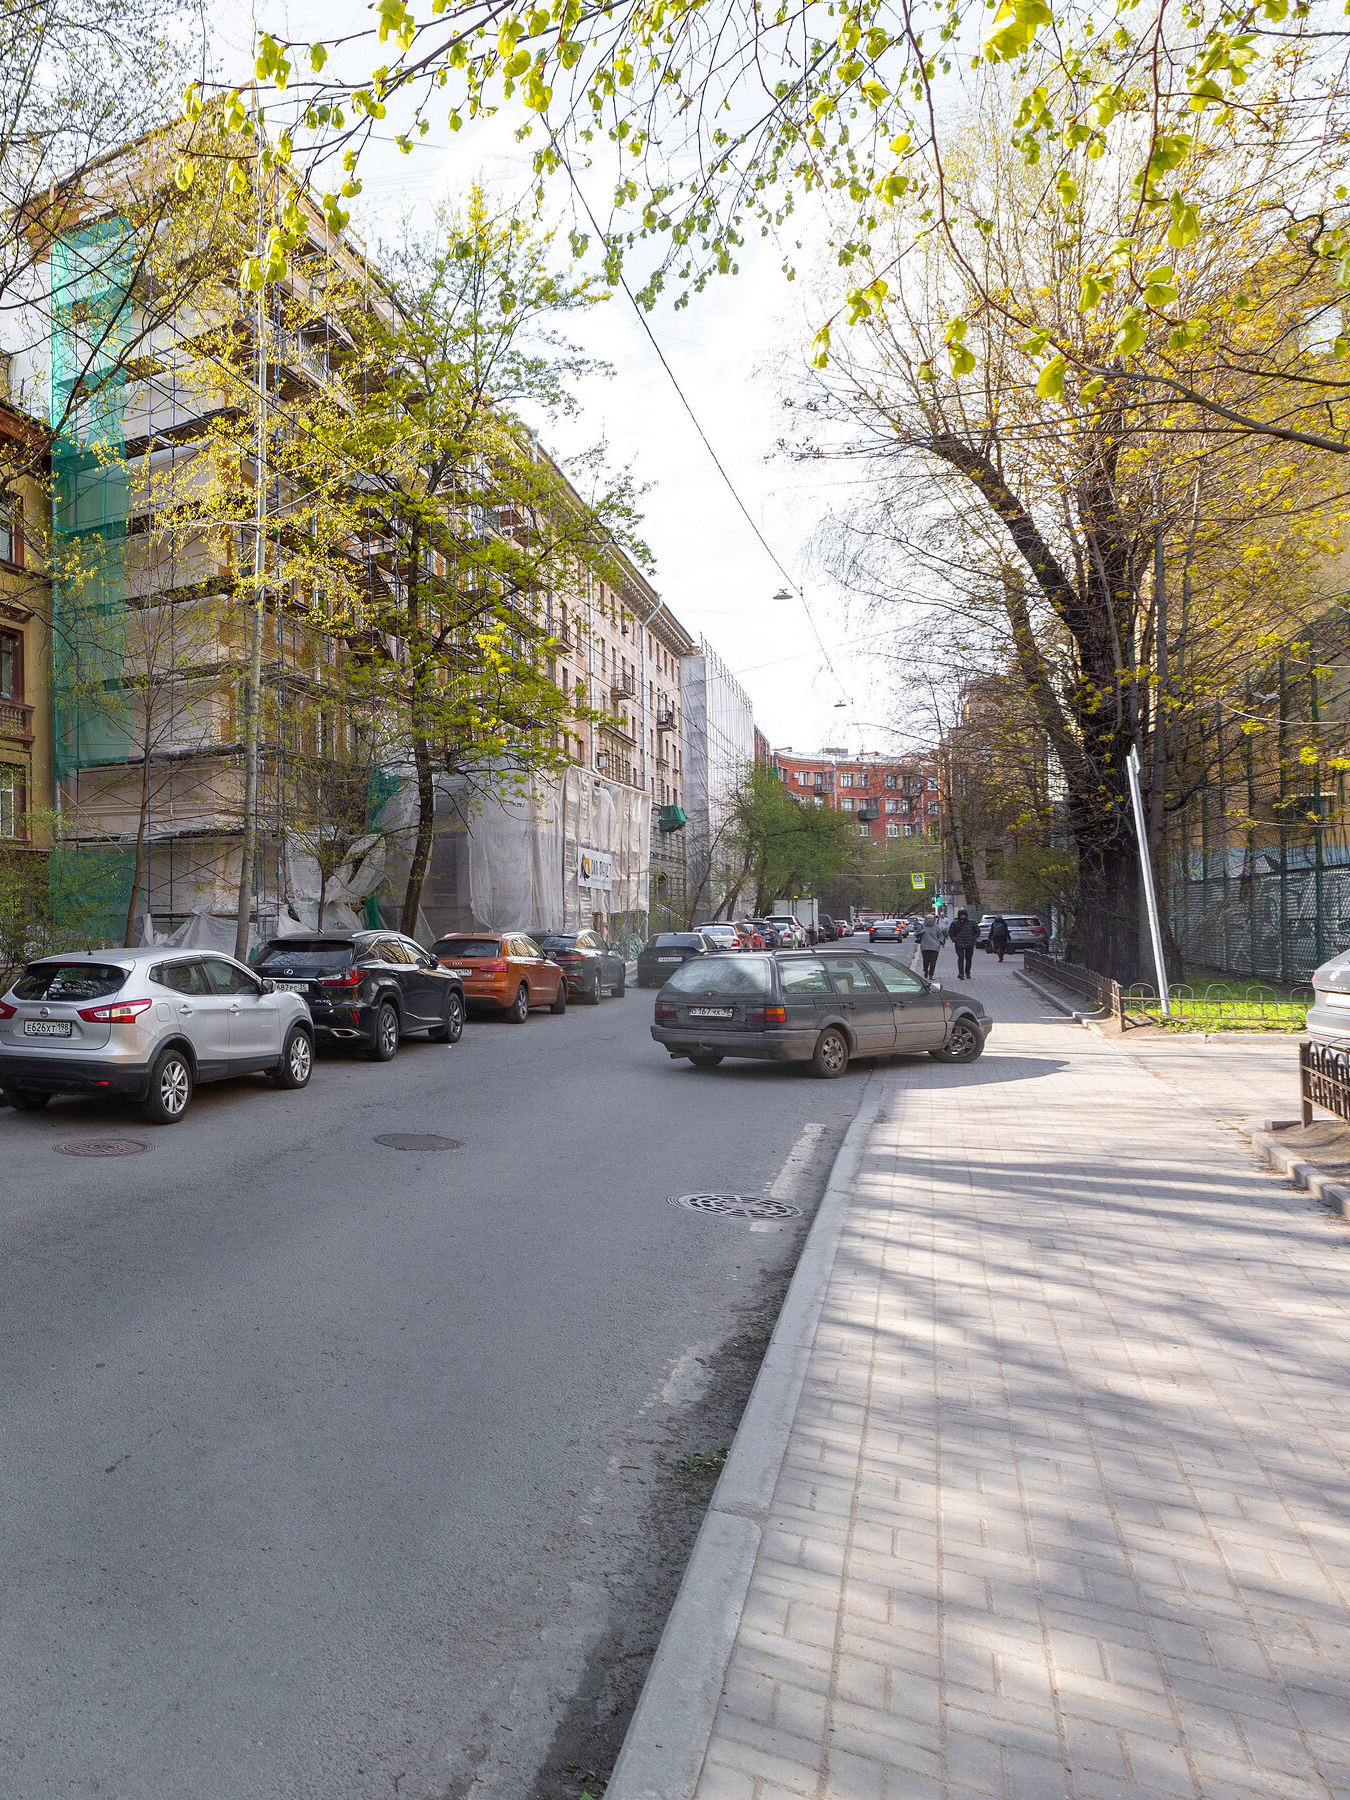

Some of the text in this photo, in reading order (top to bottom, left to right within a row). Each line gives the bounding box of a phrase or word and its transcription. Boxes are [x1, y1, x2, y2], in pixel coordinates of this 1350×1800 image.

[276, 983, 298, 992] 687РС
[26, 1022, 69, 1033] Е626ХТ 198
